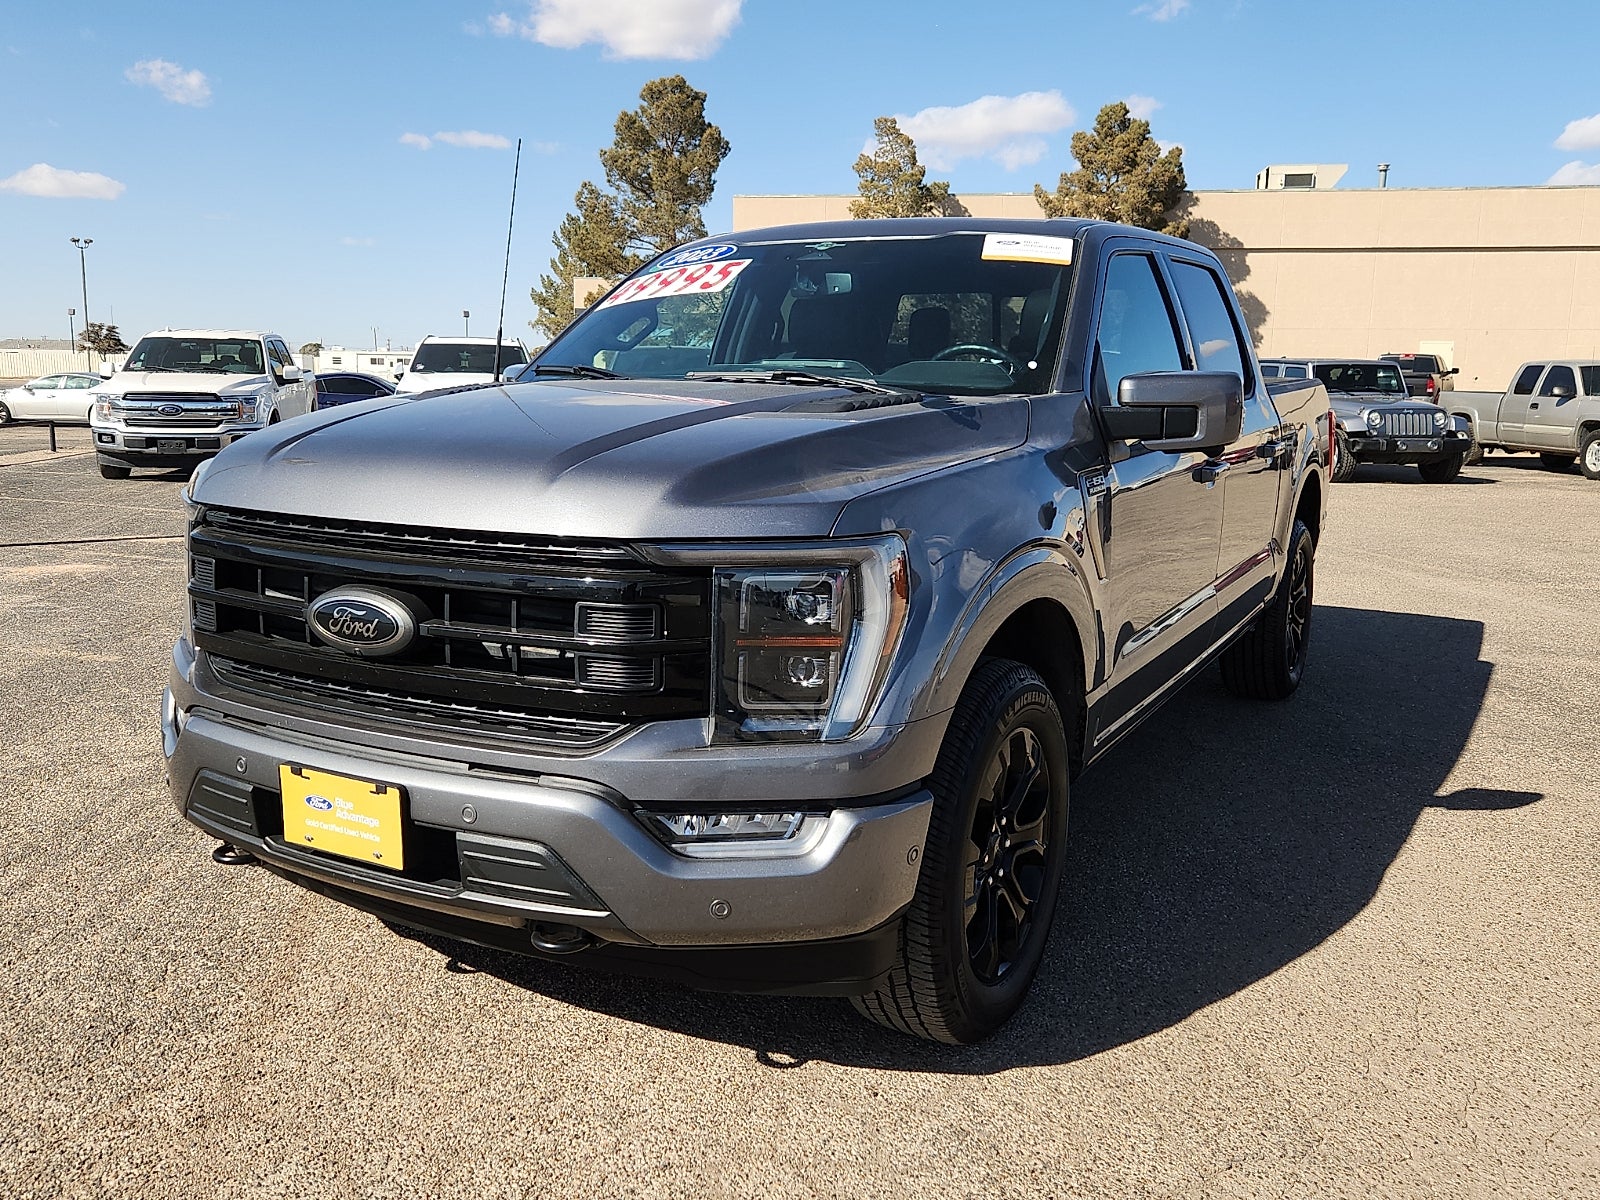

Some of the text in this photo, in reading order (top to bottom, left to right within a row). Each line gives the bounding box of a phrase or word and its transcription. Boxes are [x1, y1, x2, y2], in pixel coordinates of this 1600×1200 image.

[328, 606, 379, 638] Ford
[309, 796, 329, 809] Ford
[335, 797, 354, 810] Blue
[336, 809, 380, 828] Advantage
